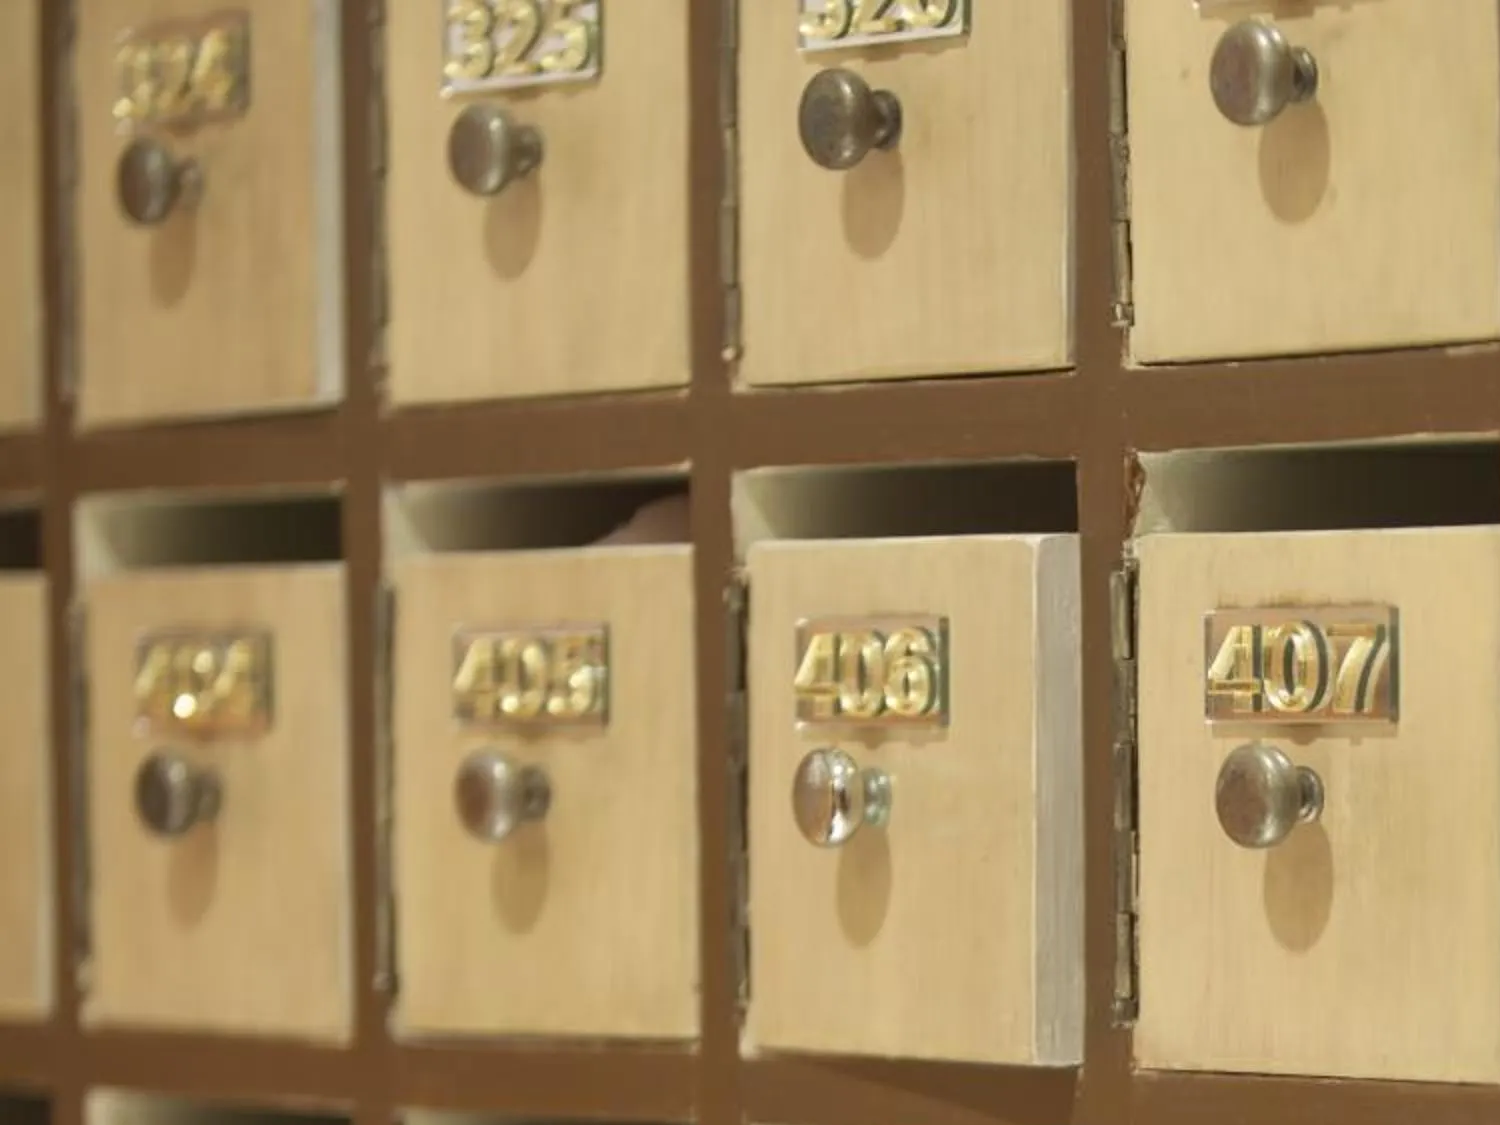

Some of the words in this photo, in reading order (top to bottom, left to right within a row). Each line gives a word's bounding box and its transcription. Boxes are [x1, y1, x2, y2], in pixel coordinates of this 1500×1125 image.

[442, 0, 596, 79] 325
[794, 627, 942, 719] 406
[1206, 620, 1391, 714] 407
